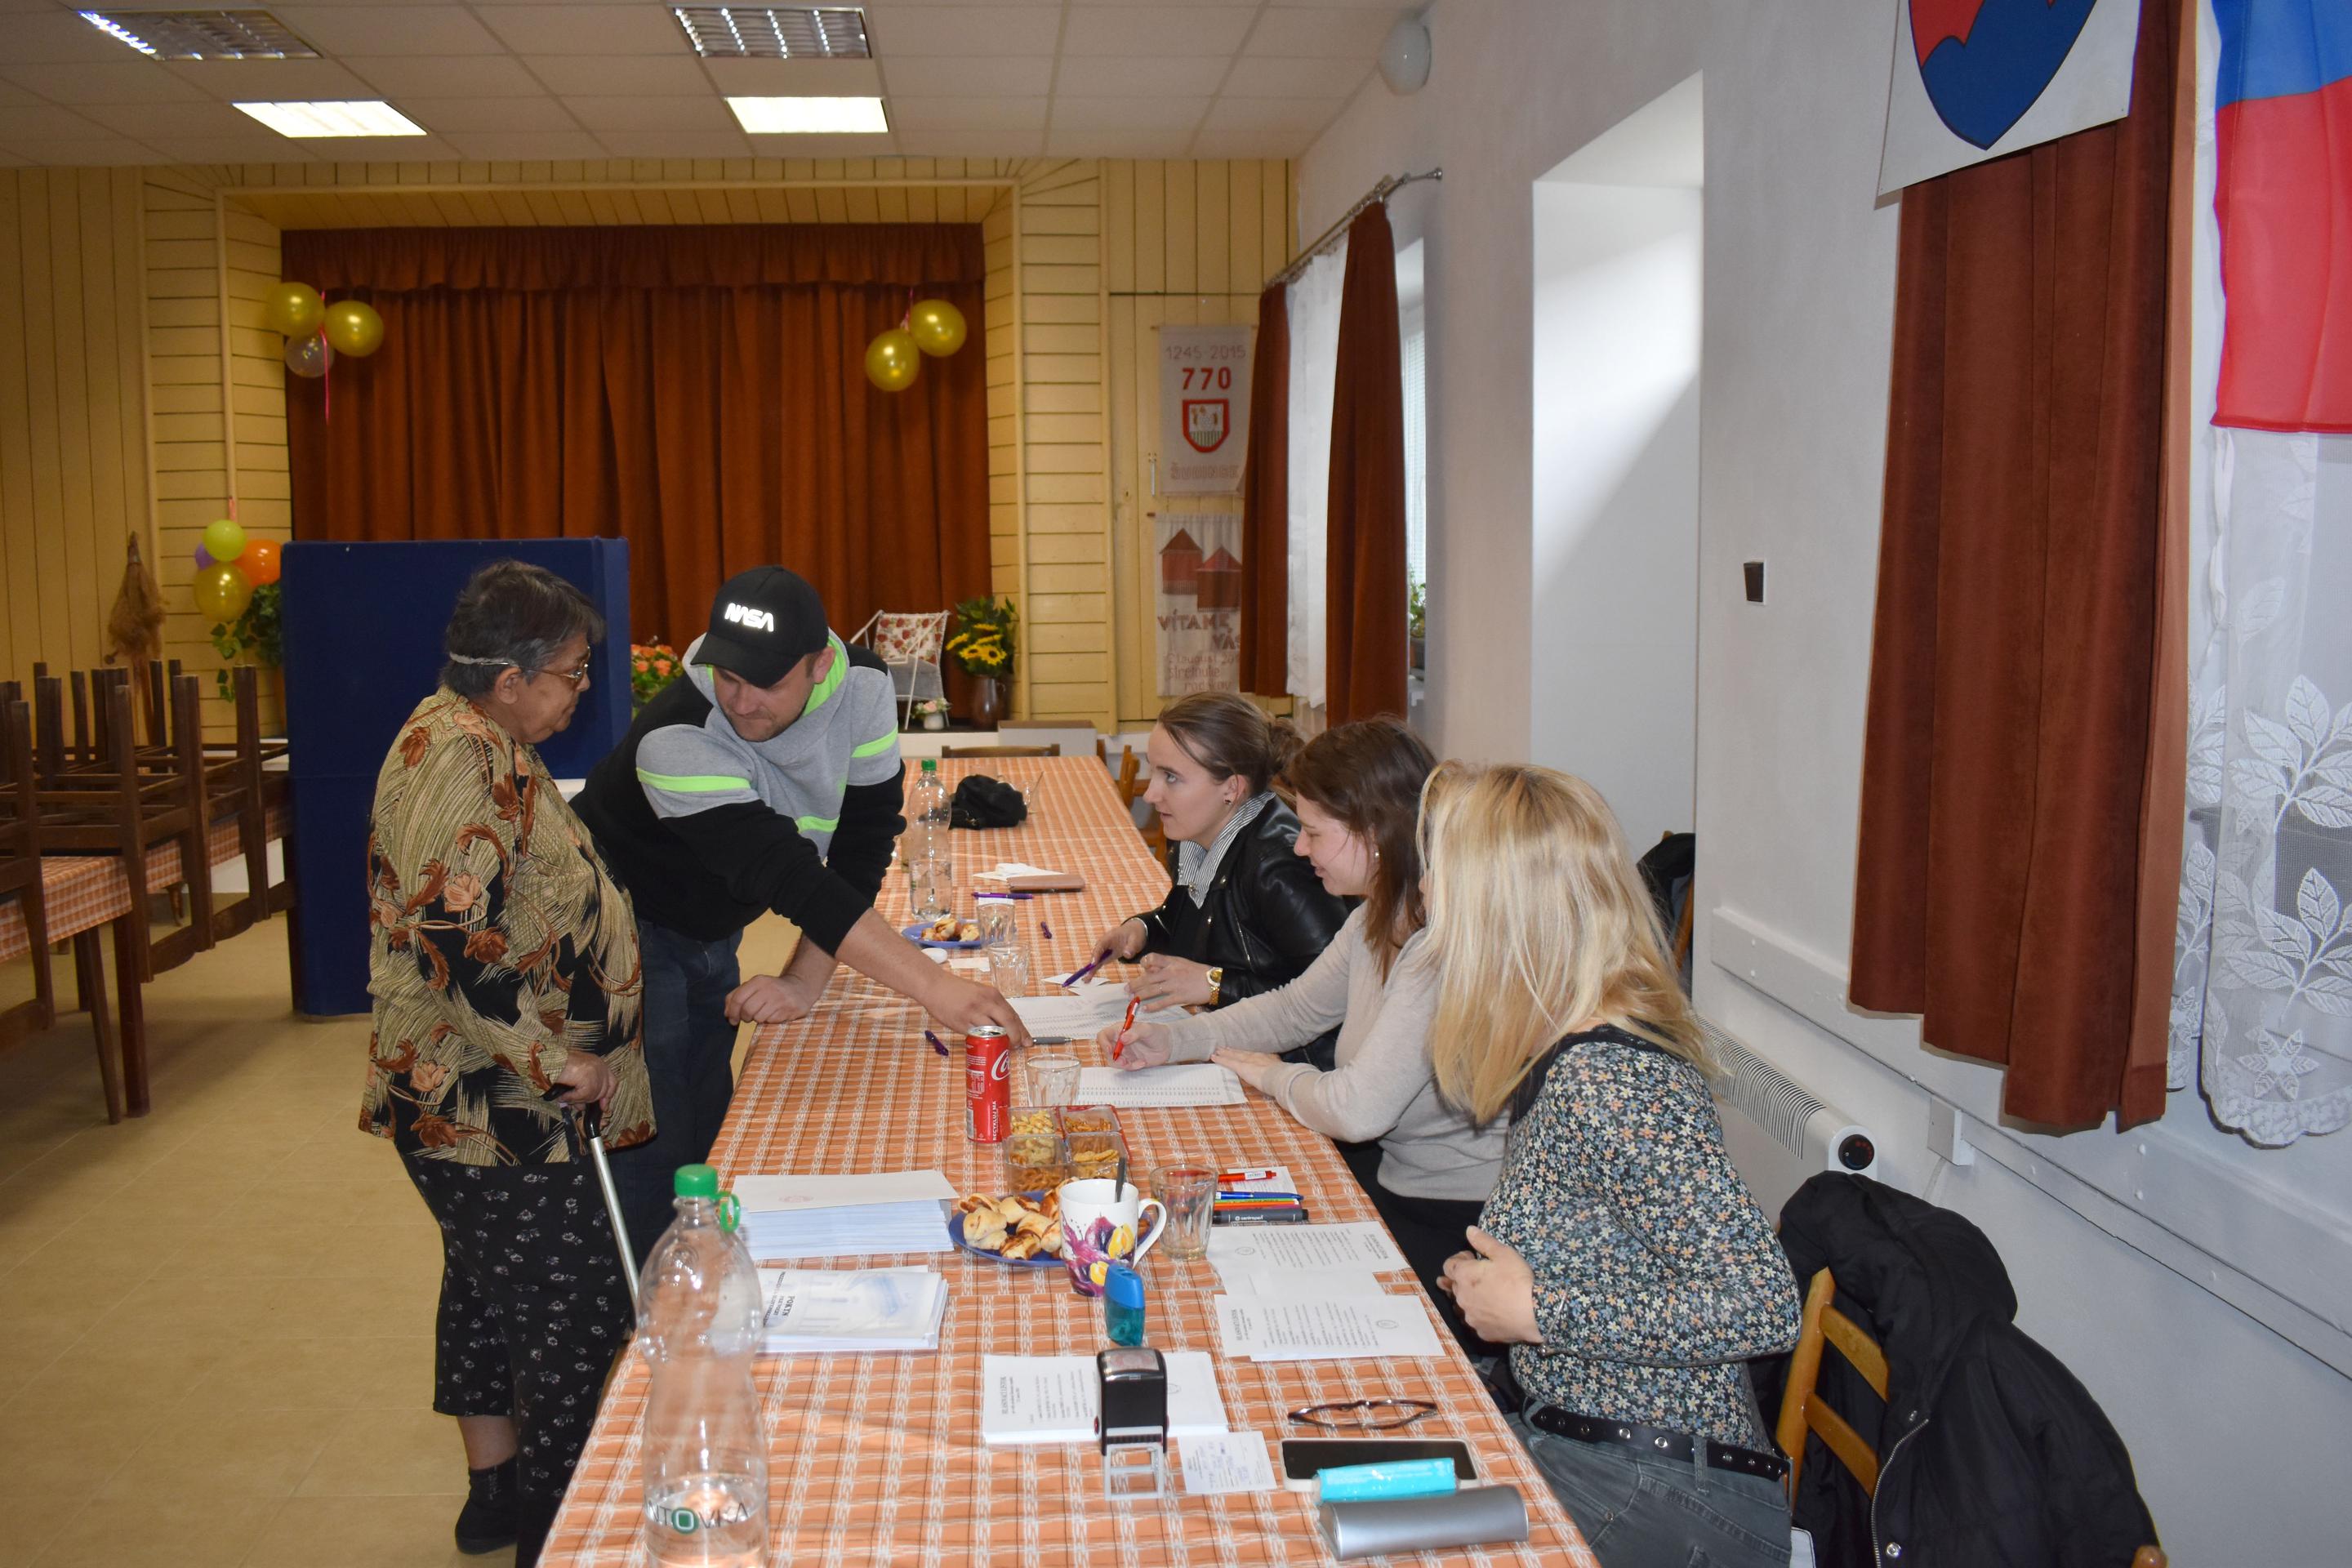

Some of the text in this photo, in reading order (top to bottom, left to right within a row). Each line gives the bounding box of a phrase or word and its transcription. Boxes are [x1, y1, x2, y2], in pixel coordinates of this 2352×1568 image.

[1166, 345, 1246, 360] 1245 2015
[1182, 367, 1232, 390] 770
[724, 603, 774, 632] NASA
[1157, 608, 1229, 631] VÍTAME
